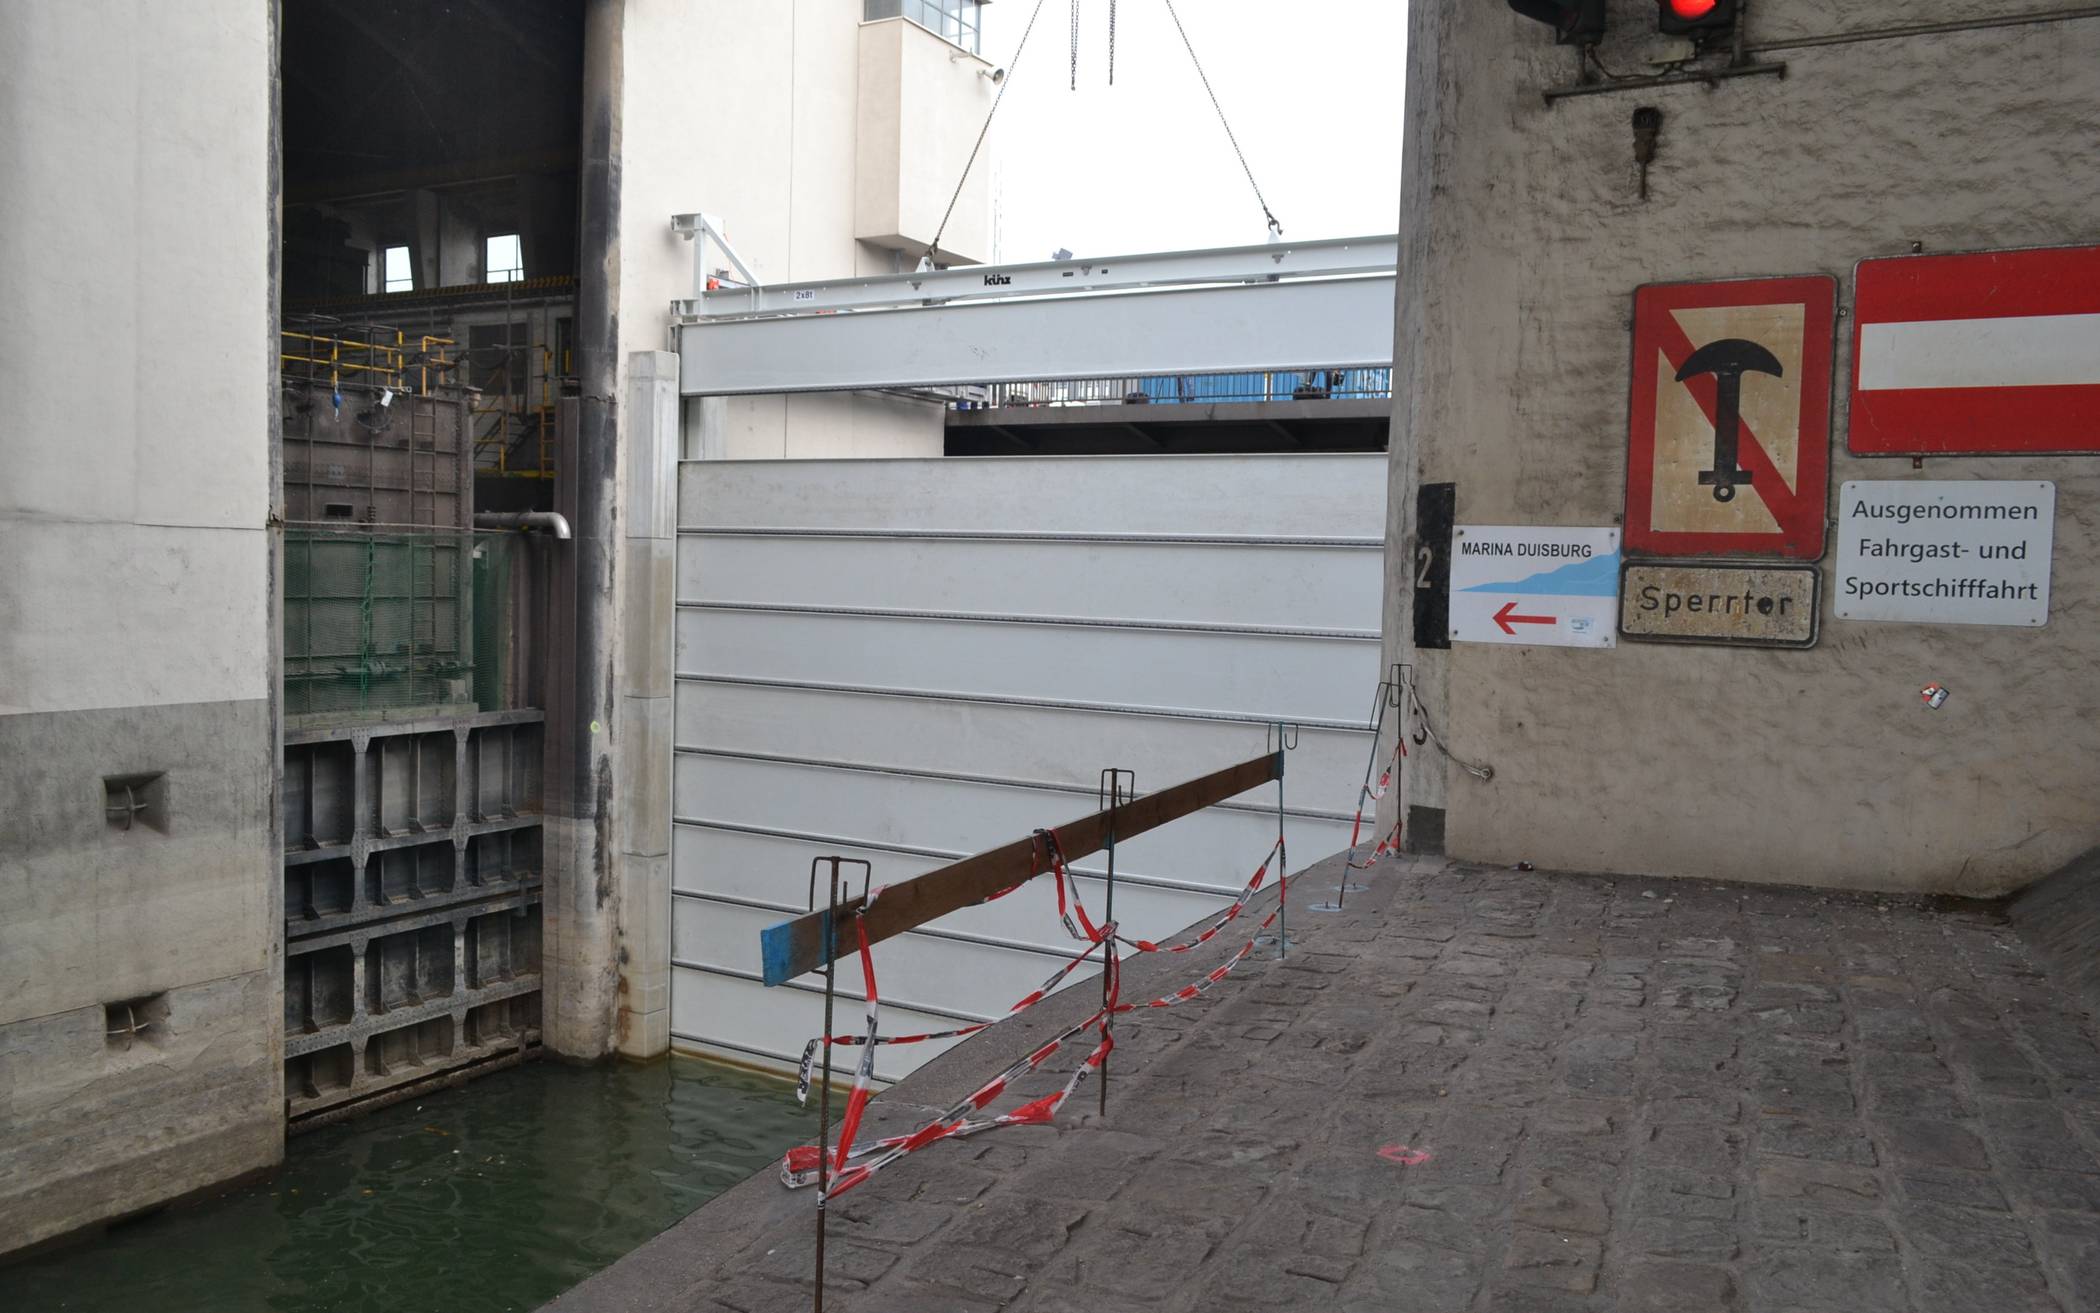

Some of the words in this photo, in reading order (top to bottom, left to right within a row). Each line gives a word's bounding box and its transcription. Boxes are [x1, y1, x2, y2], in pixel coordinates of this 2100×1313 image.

[1852, 500, 2038, 524] Ausgenommen
[1461, 542, 1513, 556] MARINA
[1517, 543, 1592, 558] DUISBURG
[1859, 538, 1970, 563] Fahrgast-
[1979, 540, 2027, 560] und
[1416, 546, 1433, 589] 2
[1845, 576, 2038, 600] Sportschifffahrt
[1640, 586, 1793, 618] Sperrtor
